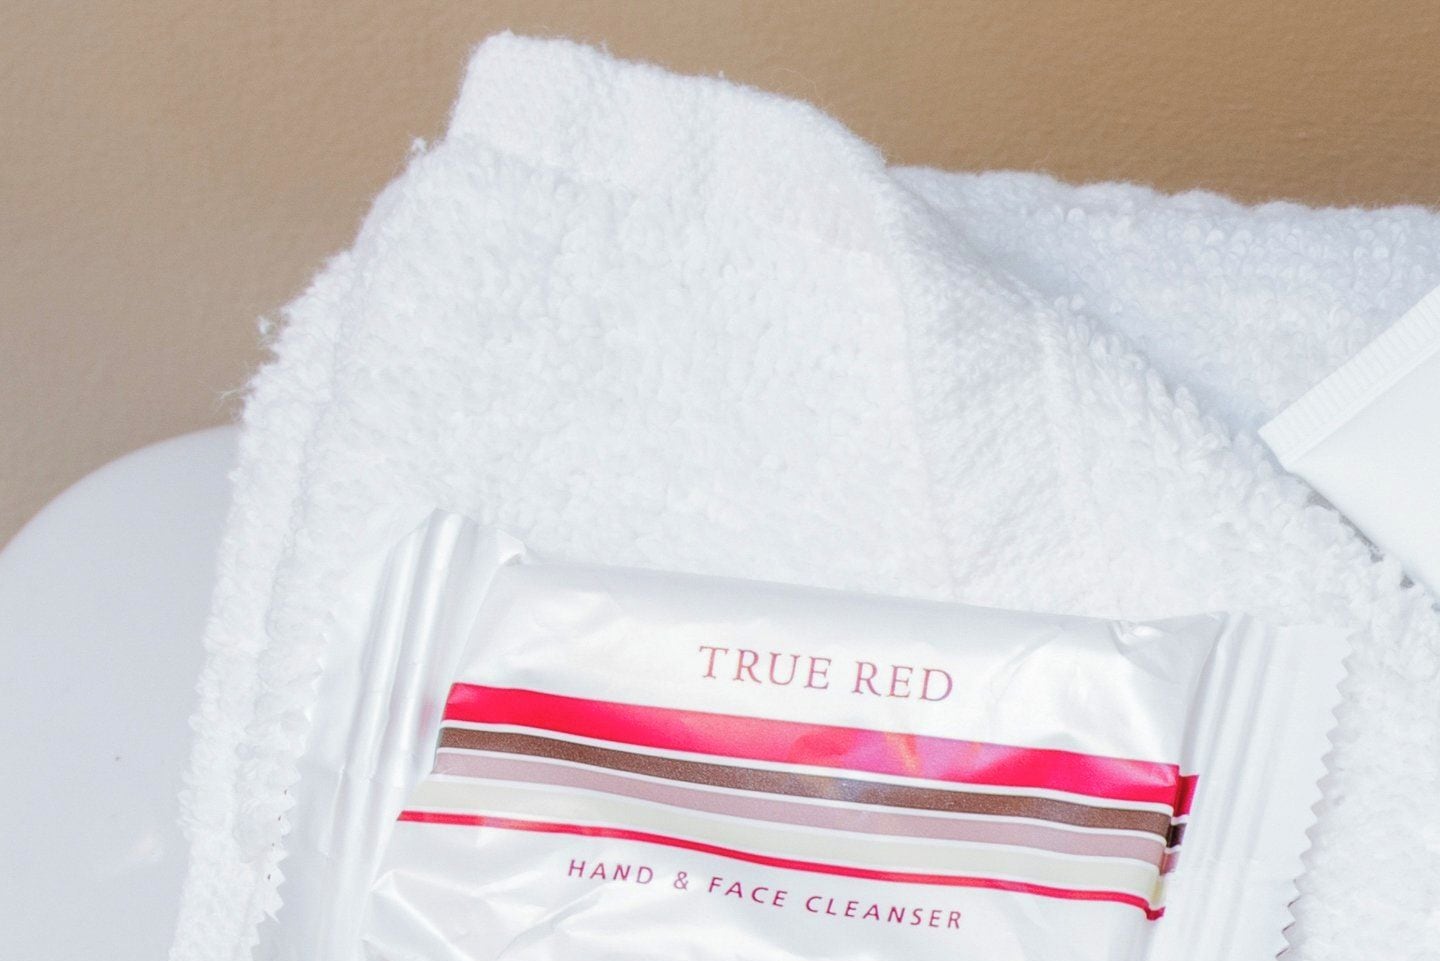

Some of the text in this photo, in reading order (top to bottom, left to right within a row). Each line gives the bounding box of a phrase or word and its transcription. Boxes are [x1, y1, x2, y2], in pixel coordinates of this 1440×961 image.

[699, 644, 954, 702] TRUE RED
[567, 858, 963, 930] HAND & FACE CLEANSER
